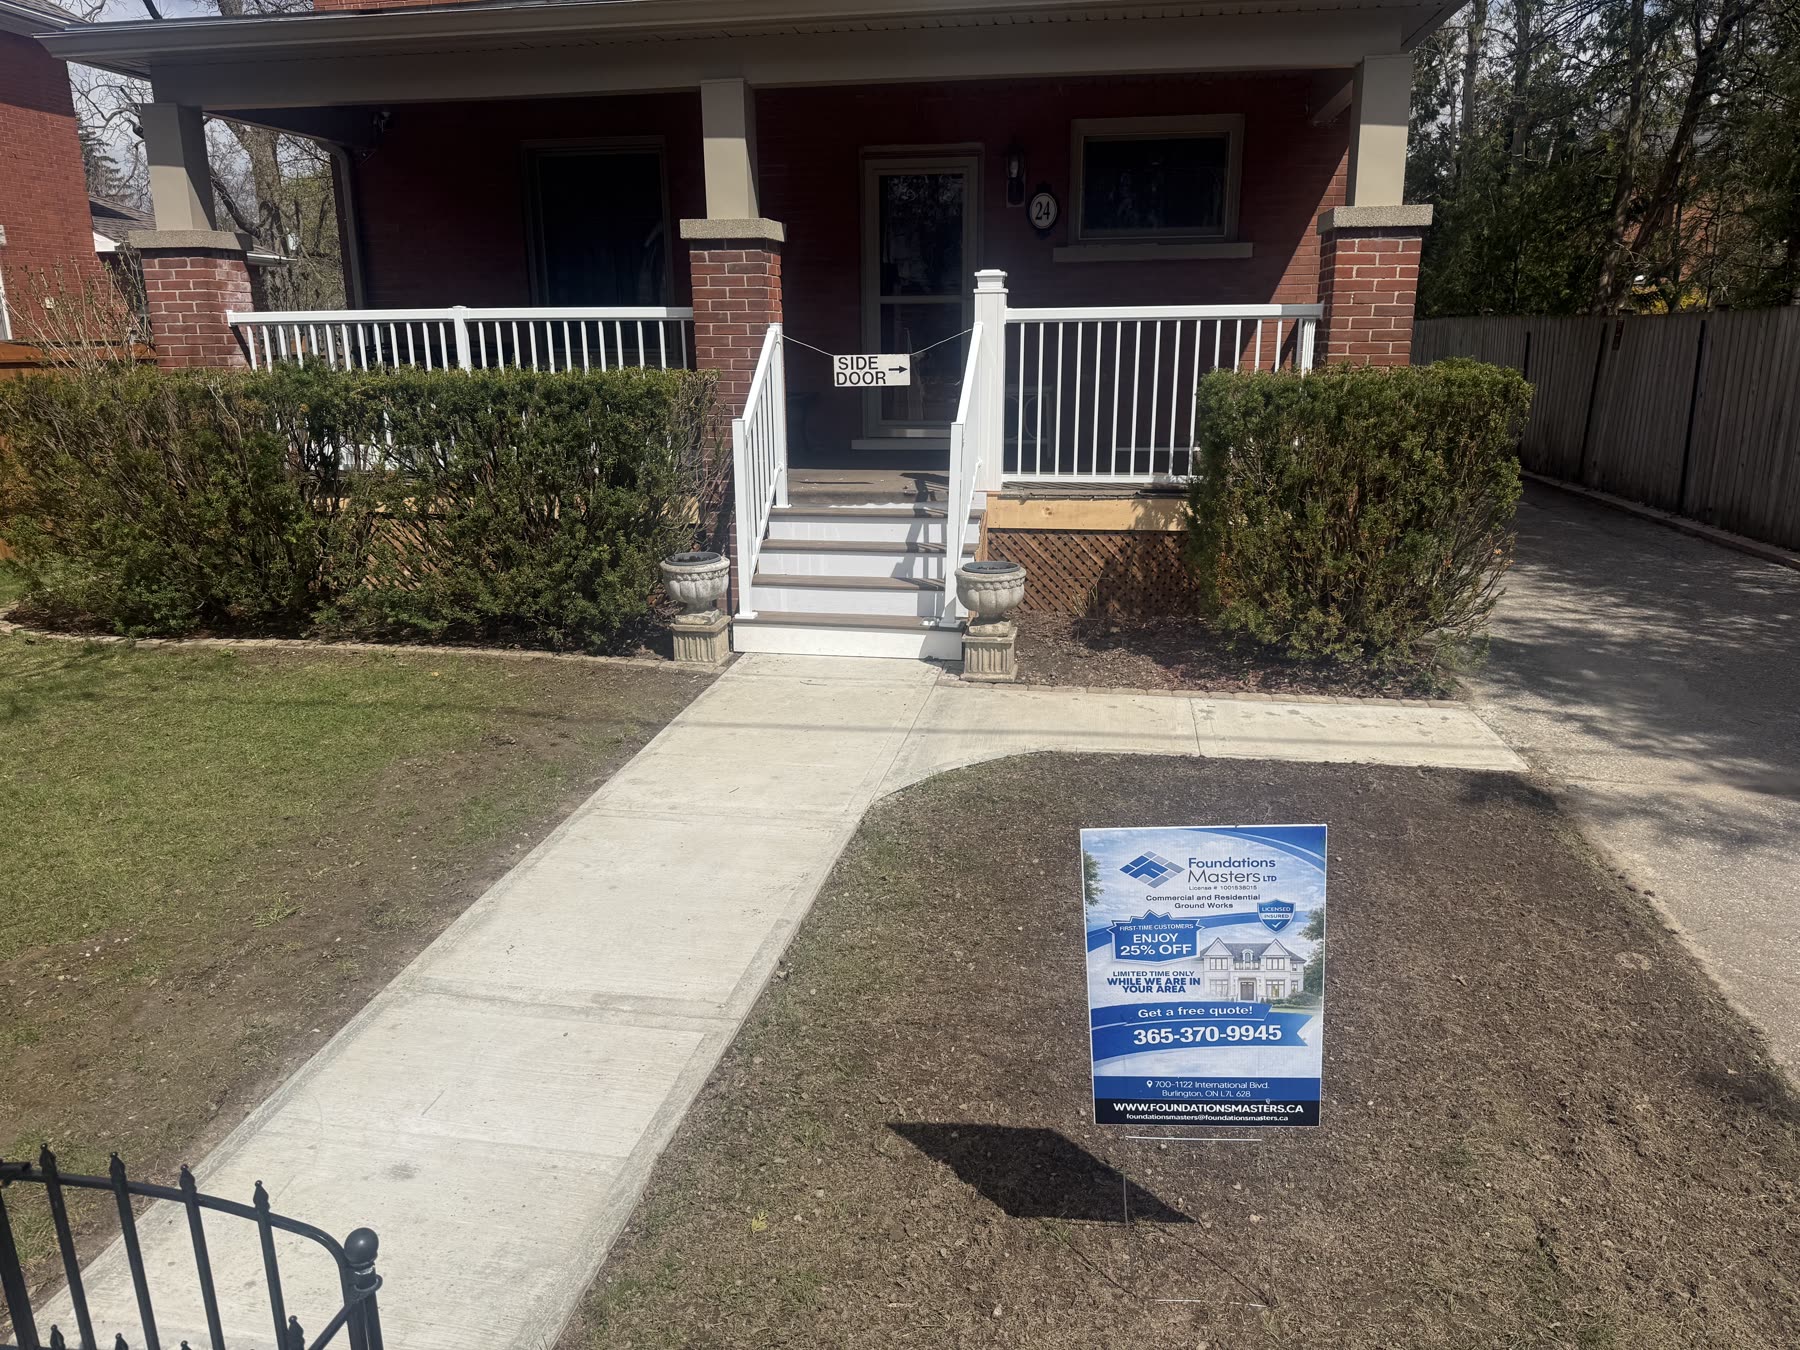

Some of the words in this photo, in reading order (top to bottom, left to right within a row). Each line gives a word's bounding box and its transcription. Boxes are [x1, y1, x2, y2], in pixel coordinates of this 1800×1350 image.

[1035, 201, 1050, 220] 24
[838, 356, 879, 370] SIDE
[836, 371, 886, 385] DOOR
[1188, 857, 1276, 868] Foundations
[1188, 869, 1261, 883] Masters
[1133, 933, 1178, 944] ENJOY
[1120, 945, 1156, 956] 25%
[1159, 944, 1192, 955] OFF
[1107, 978, 1142, 986] WHILE
[1144, 978, 1162, 986] WE
[1165, 978, 1187, 986] ARE
[1189, 978, 1201, 986] IN
[1122, 985, 1153, 993] YOUR
[1156, 985, 1186, 993] AREA
[1138, 1009, 1162, 1018] Get
[1177, 1006, 1205, 1015] free
[1209, 1006, 1253, 1017] quote!
[1133, 1024, 1282, 1045] 365-370-9945
[1194, 1081, 1247, 1089] International
[1162, 1090, 1204, 1098] Burlington,
[1113, 1103, 1304, 1113] WWW.FOUNDATIONSMASTERS.CA
[1126, 1113, 1288, 1121] foundationsmasters@foundationsmasters.ca
